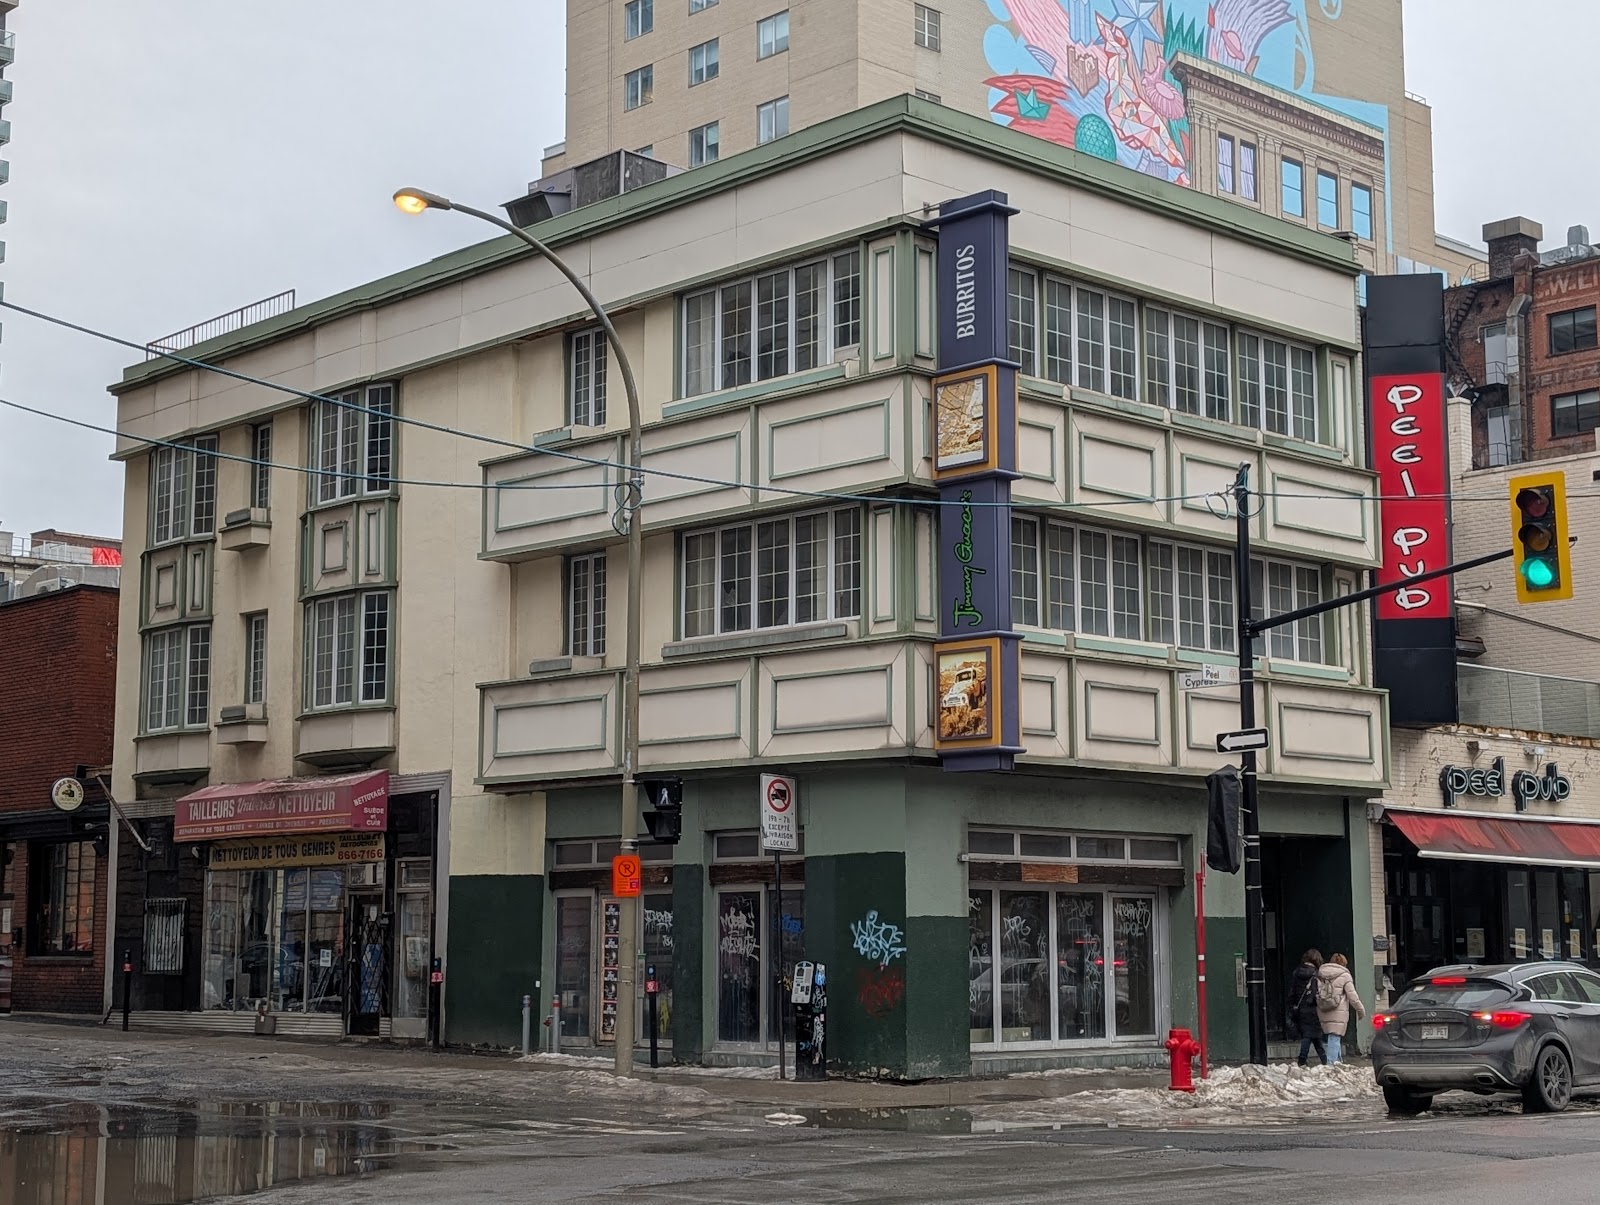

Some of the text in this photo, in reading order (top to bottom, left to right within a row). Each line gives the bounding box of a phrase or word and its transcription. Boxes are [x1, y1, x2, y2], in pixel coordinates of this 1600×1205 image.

[956, 244, 975, 340] BURRITOS
[953, 564, 987, 627] Jimmy
[1185, 678, 1218, 689] Cypress
[1205, 669, 1220, 680] Peel
[189, 800, 235, 821] TAILLEURS
[278, 791, 336, 814] NETTOYEUR
[353, 787, 386, 807] NETTOYAGE
[212, 841, 336, 863] NETTOYEUR DE TOUS GENRES
[769, 839, 790, 847] LOCALE
